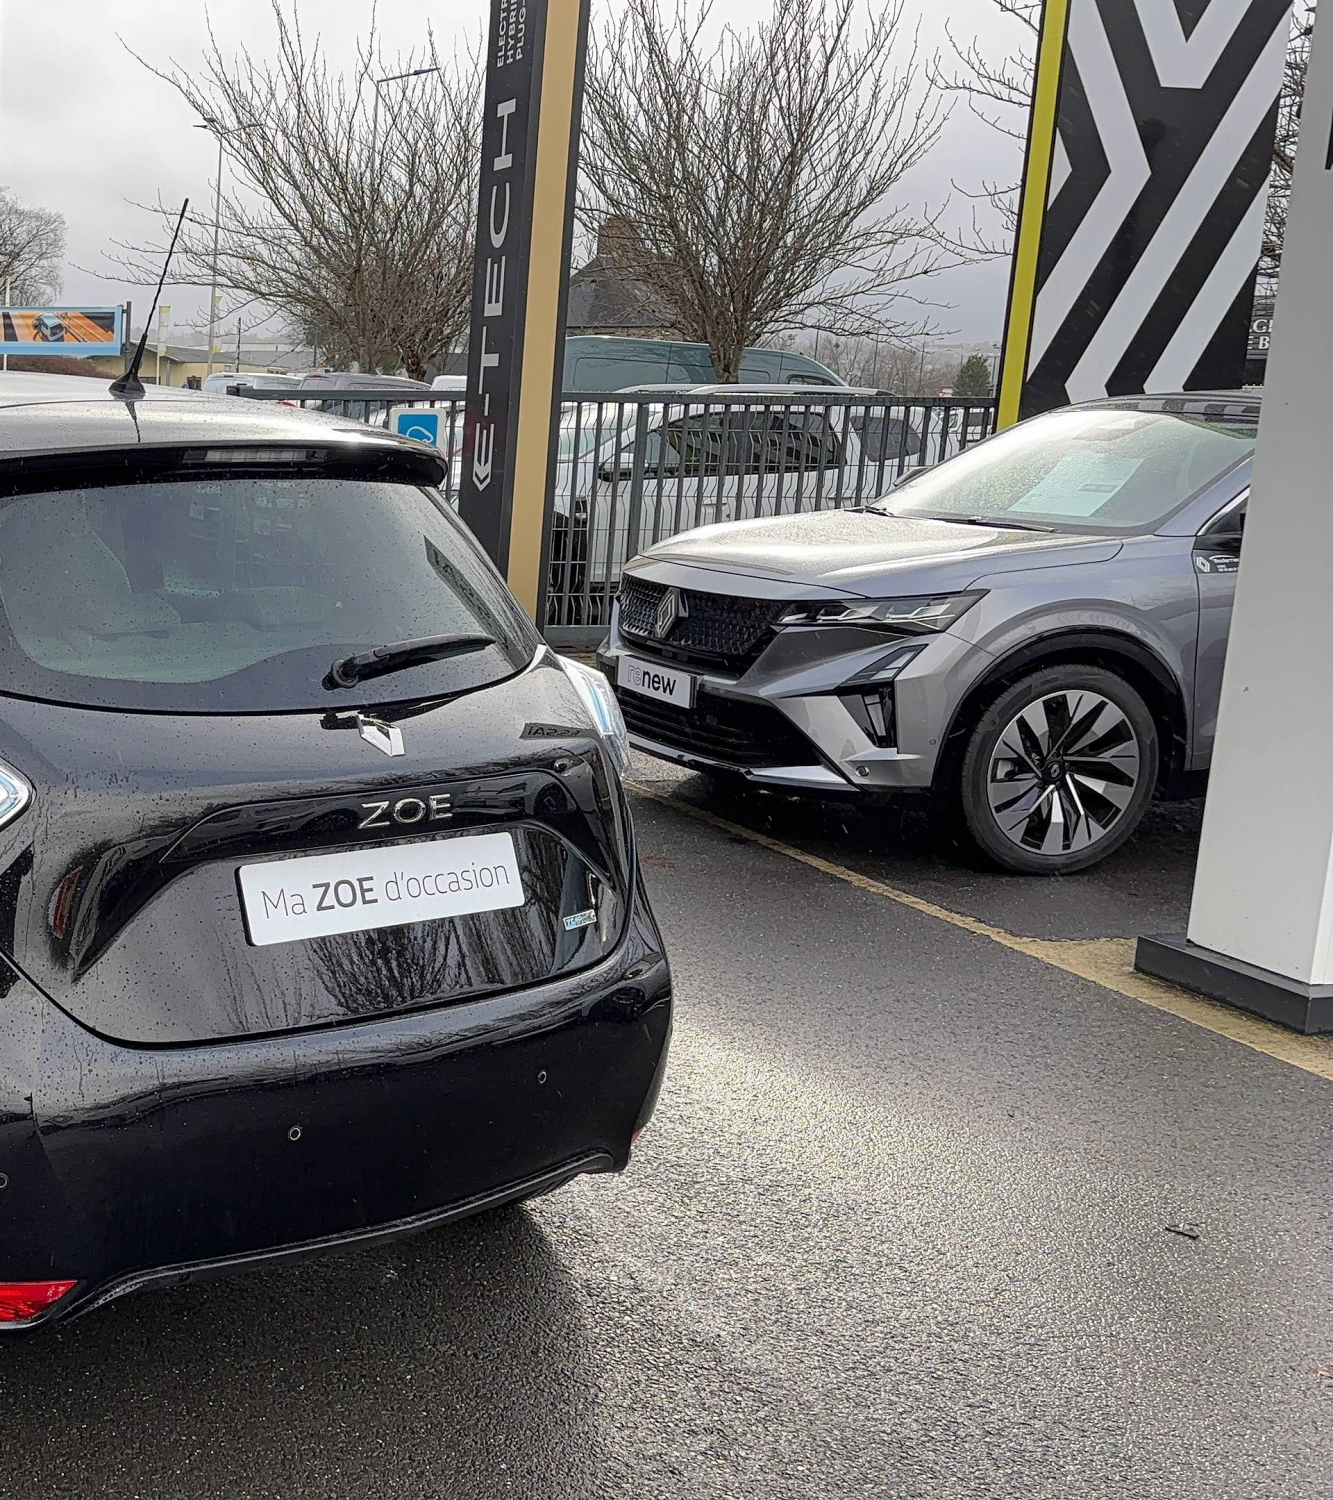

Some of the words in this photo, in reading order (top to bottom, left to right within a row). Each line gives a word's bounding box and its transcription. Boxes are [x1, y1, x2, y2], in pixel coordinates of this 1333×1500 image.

[473, 98, 517, 492] E-TECH
[627, 664, 677, 696] renew
[358, 793, 453, 829] ZOE
[261, 888, 308, 919] Ma
[312, 875, 378, 912] ZOE
[384, 862, 511, 902] d'occasion
